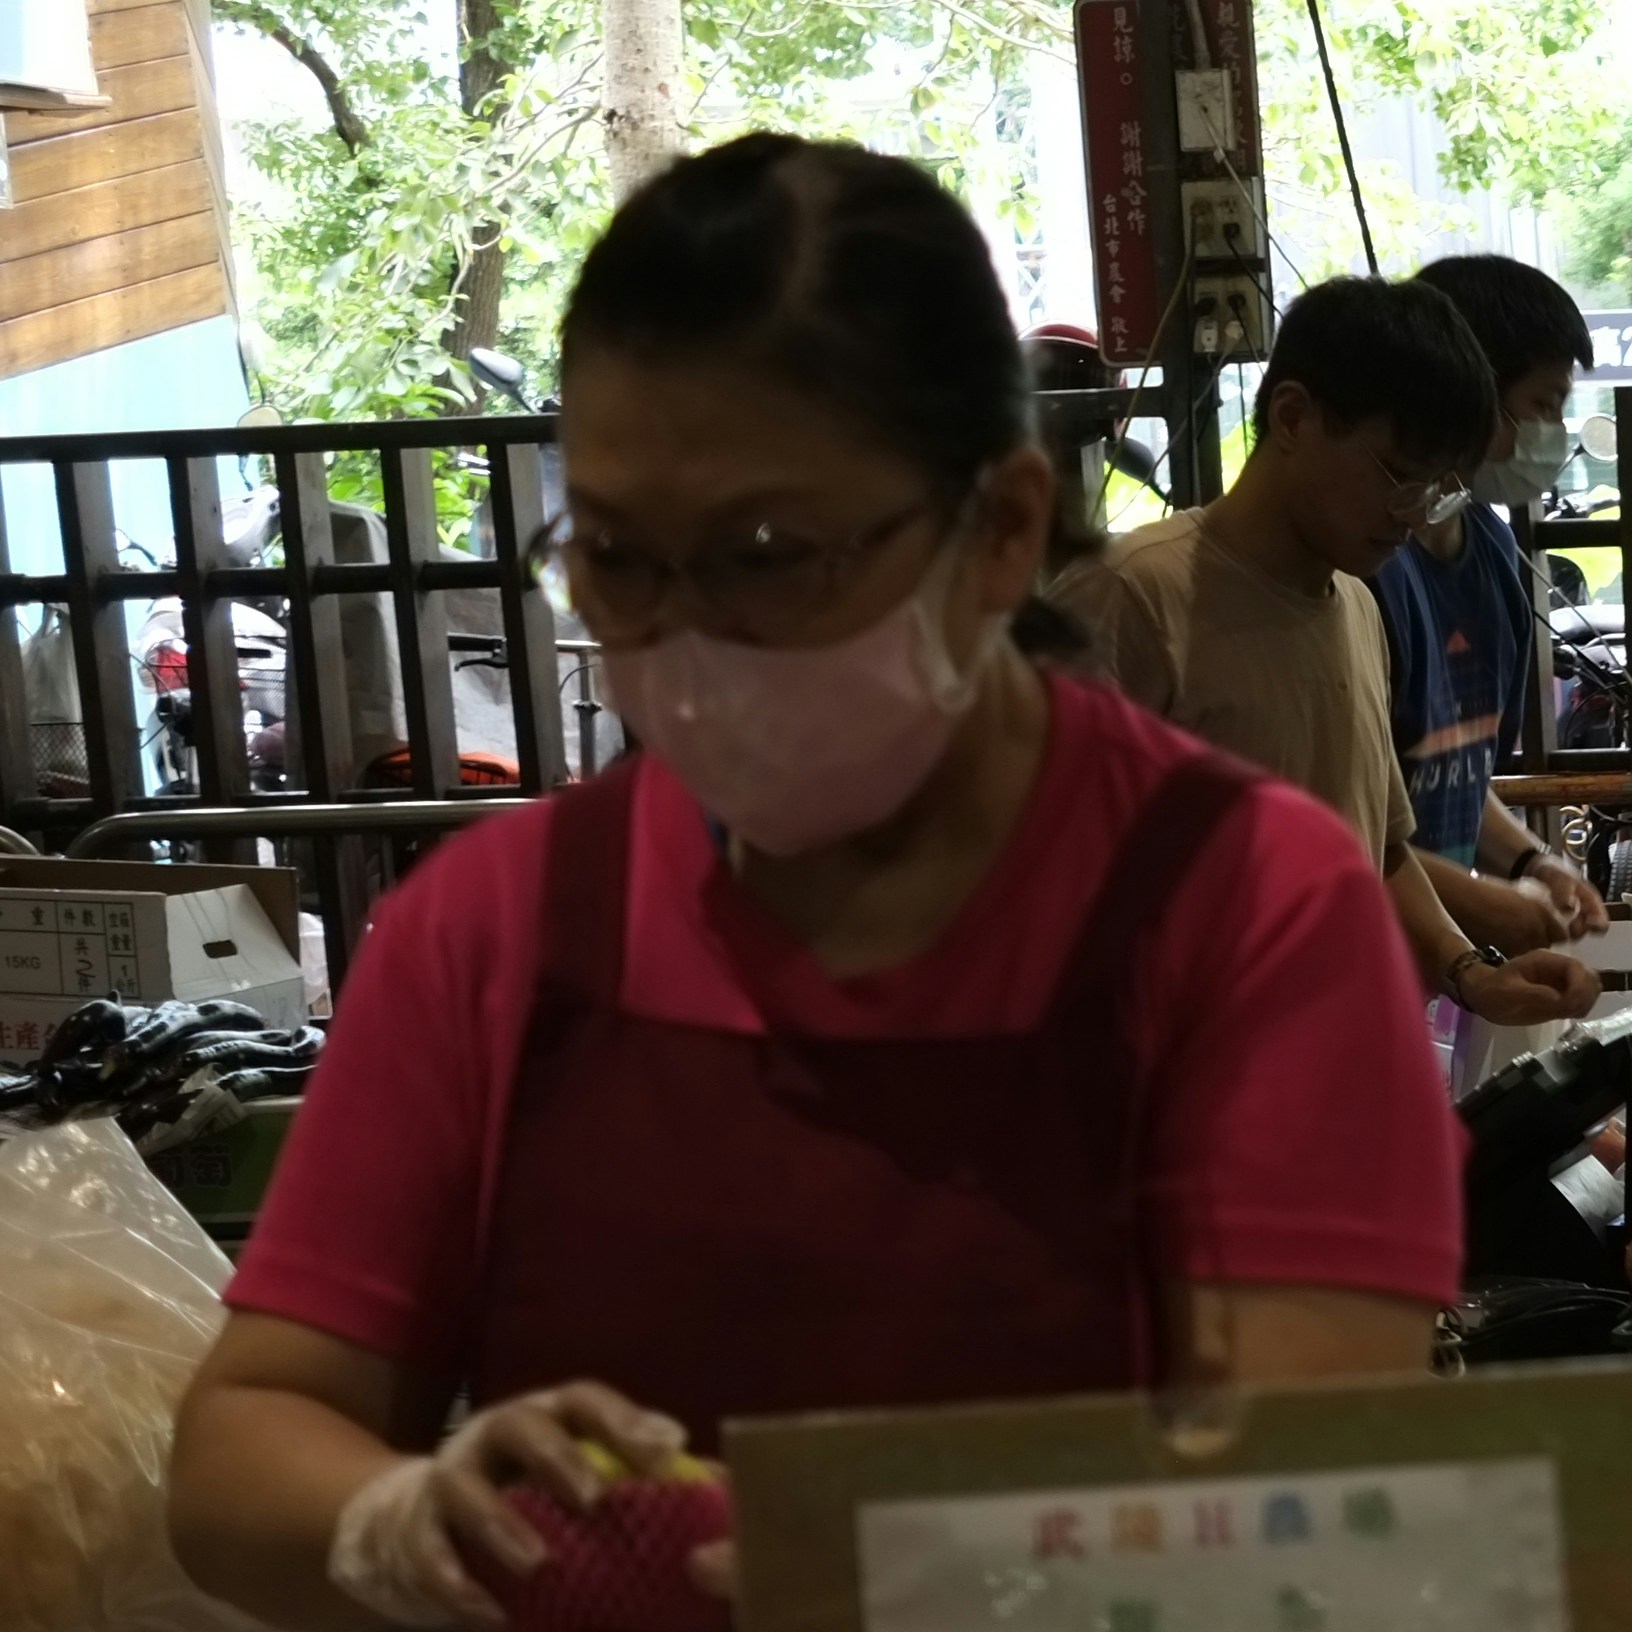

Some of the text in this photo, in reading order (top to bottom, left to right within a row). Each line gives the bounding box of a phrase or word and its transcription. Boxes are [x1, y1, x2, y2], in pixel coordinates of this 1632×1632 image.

[1120, 121, 1147, 237] 謝謝合作
[1102, 194, 1127, 304] 台北市農會
[5, 955, 42, 970] 15KG
